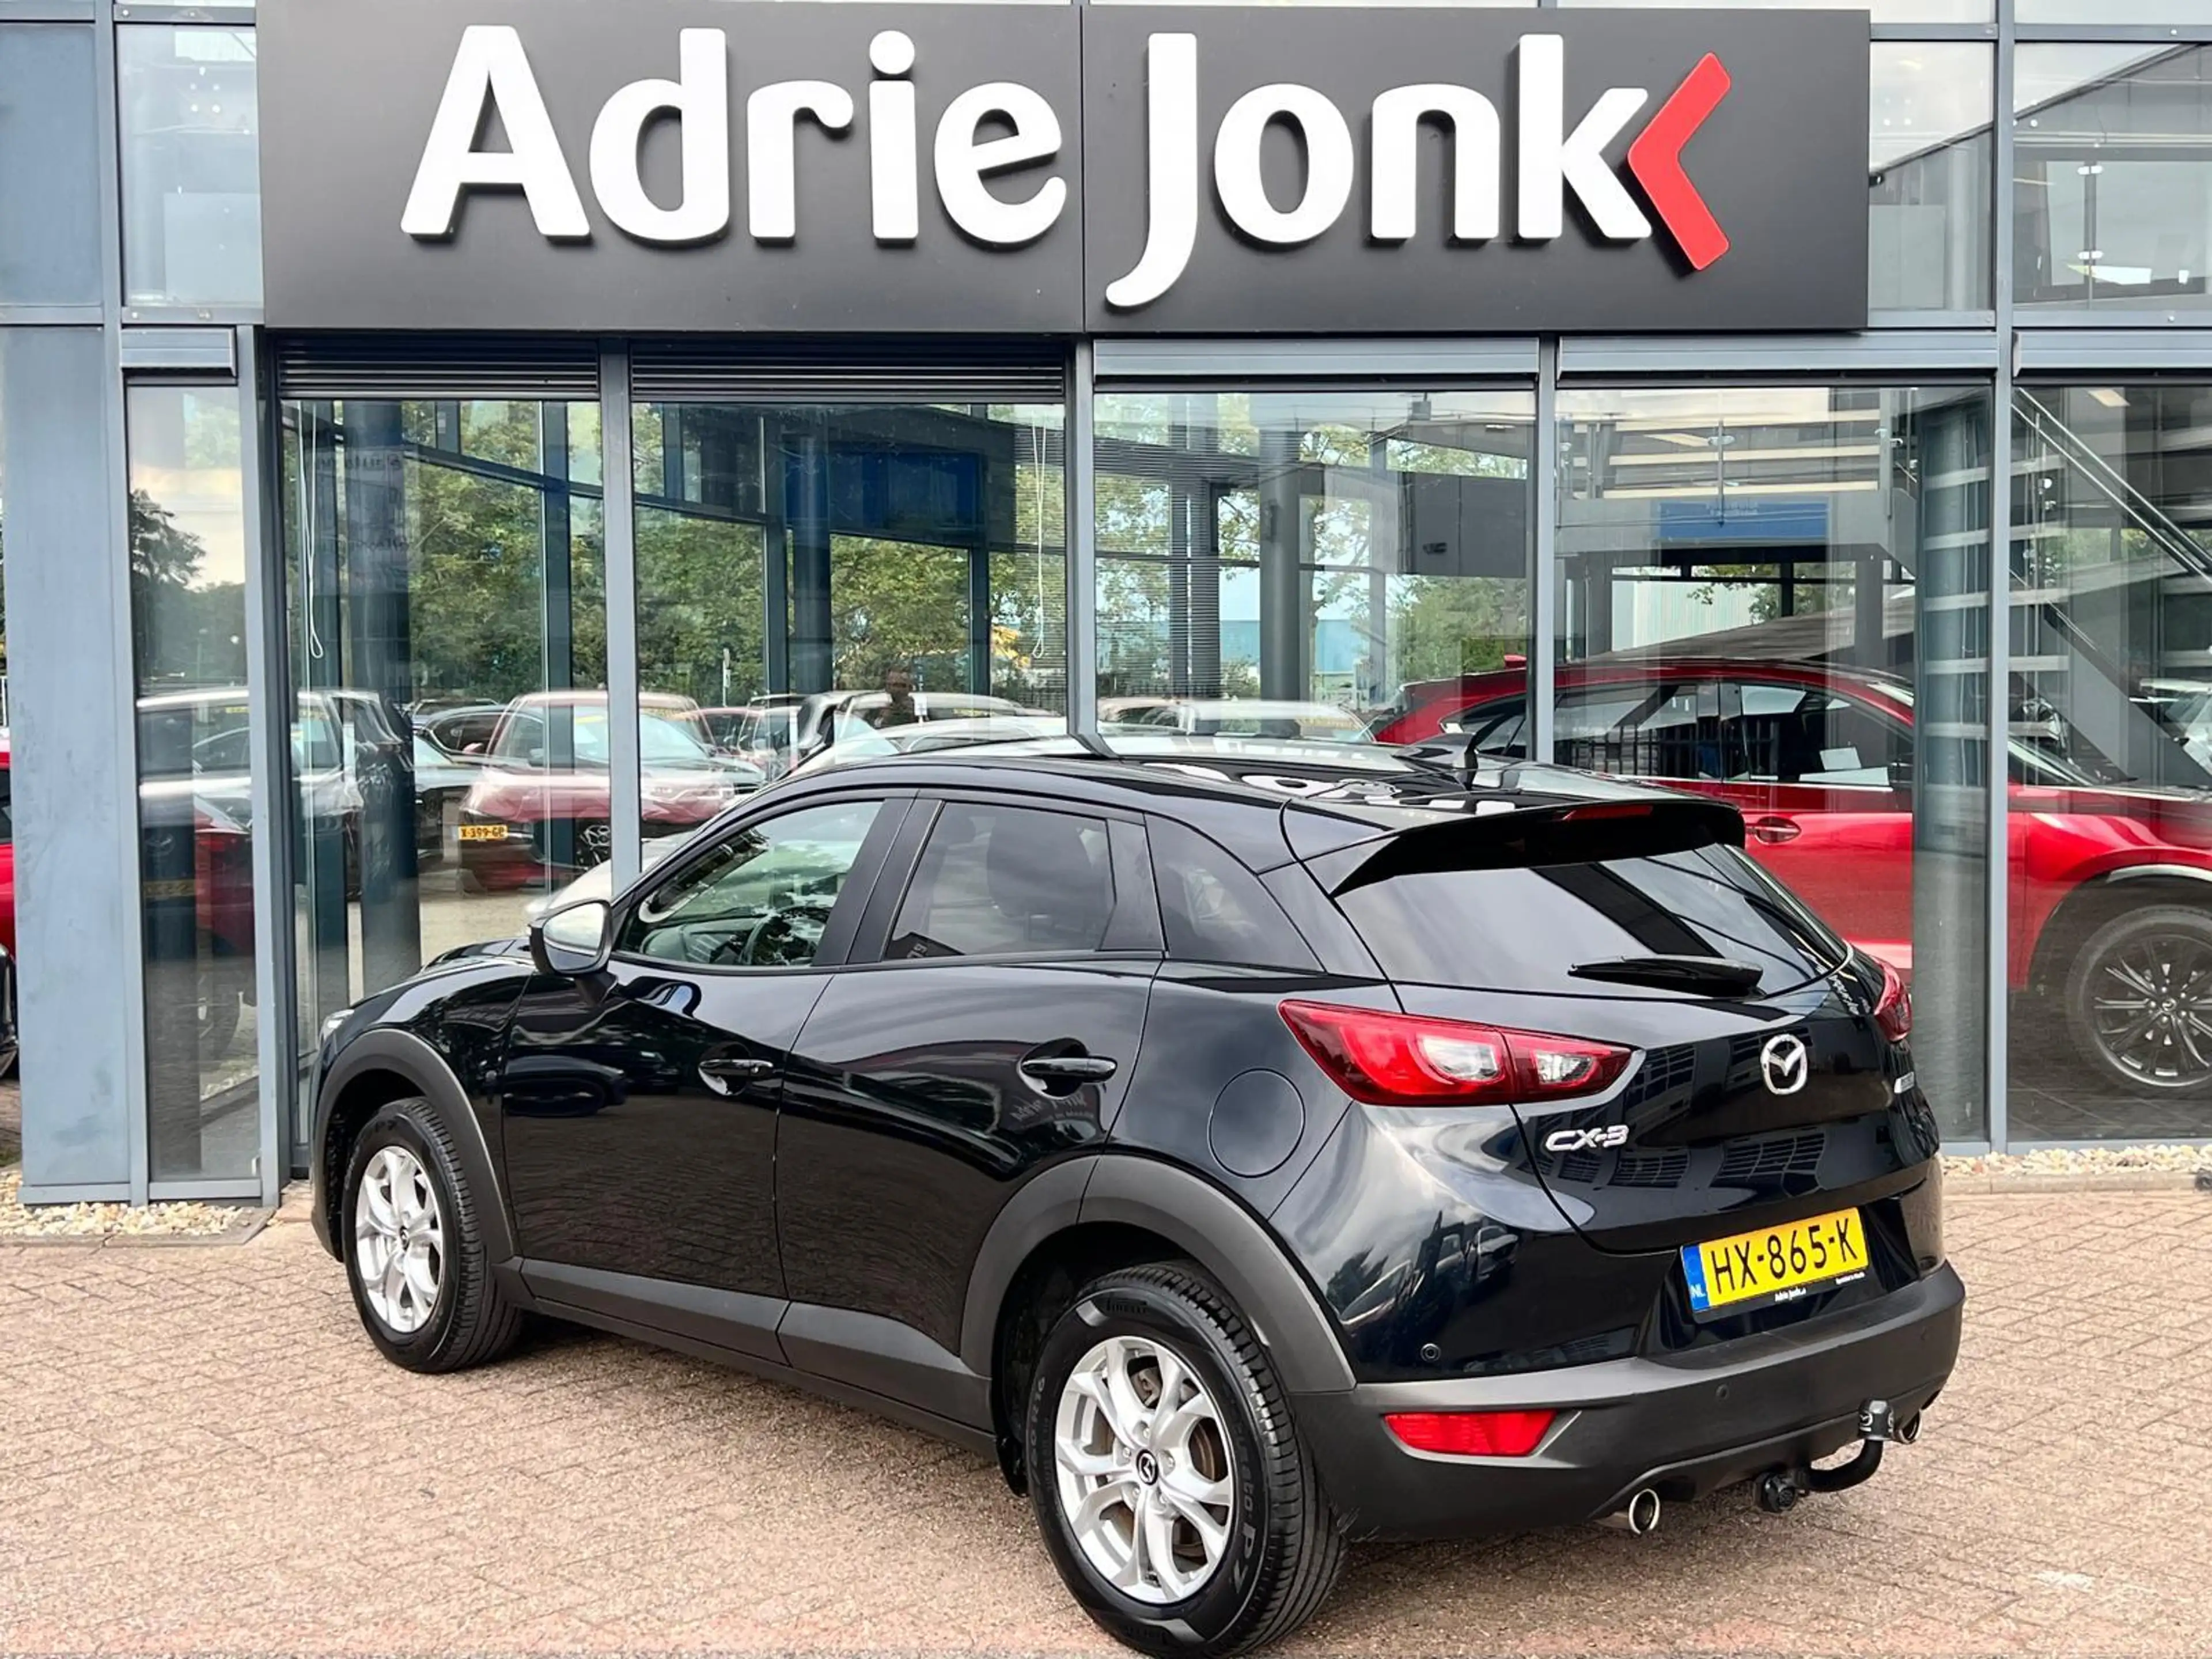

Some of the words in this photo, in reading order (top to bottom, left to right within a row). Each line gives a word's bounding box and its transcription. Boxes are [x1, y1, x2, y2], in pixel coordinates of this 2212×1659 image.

[400, 25, 1067, 244] Adrie
[1105, 32, 1652, 307] Jonk
[1546, 1125, 1629, 1151] CX-3
[1711, 1218, 1858, 1294] HX-865-K
[1691, 1284, 1706, 1299] NL
